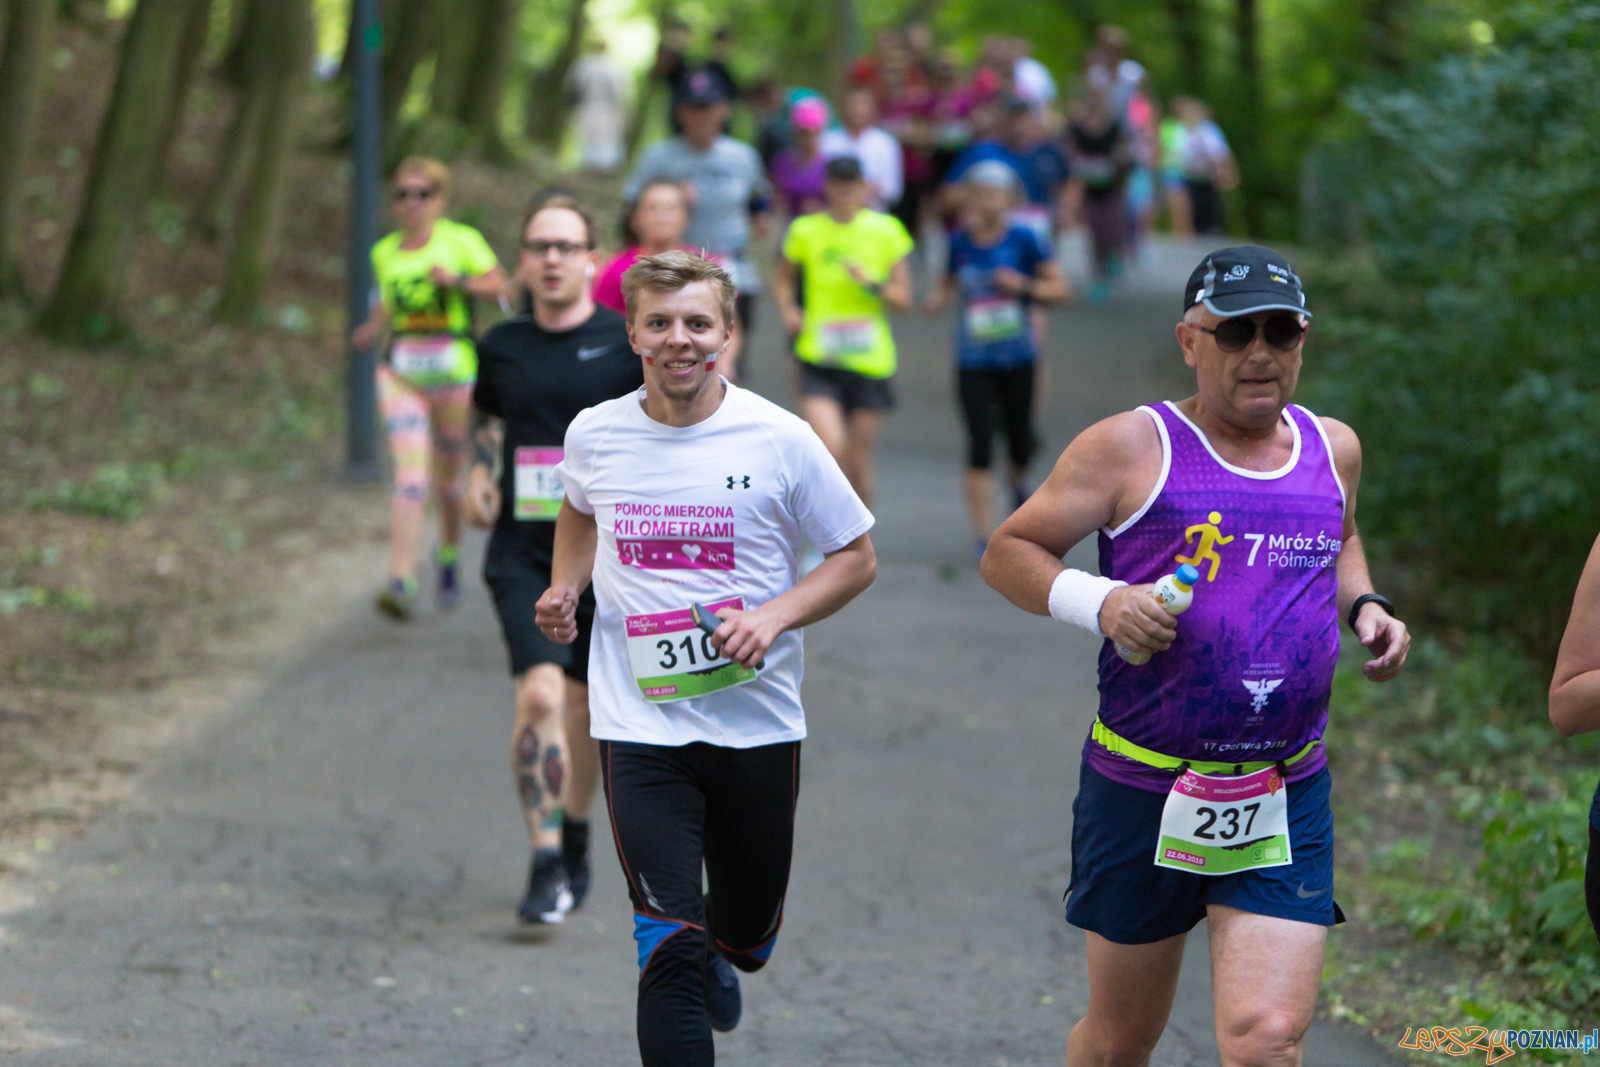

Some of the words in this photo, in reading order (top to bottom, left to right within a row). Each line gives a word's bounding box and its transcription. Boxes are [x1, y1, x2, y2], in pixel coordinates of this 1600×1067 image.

[615, 503, 661, 517] POMOC
[664, 505, 734, 518] MIERZONA
[614, 519, 734, 538] KILOMETRAMI
[708, 551, 728, 562] km
[1244, 533, 1265, 566] 7
[1268, 532, 1313, 550] Mróz
[656, 634, 721, 669] 310
[1203, 742, 1217, 751] 17
[1193, 802, 1261, 840] 237
[1166, 850, 1204, 865] 22.06.2018
